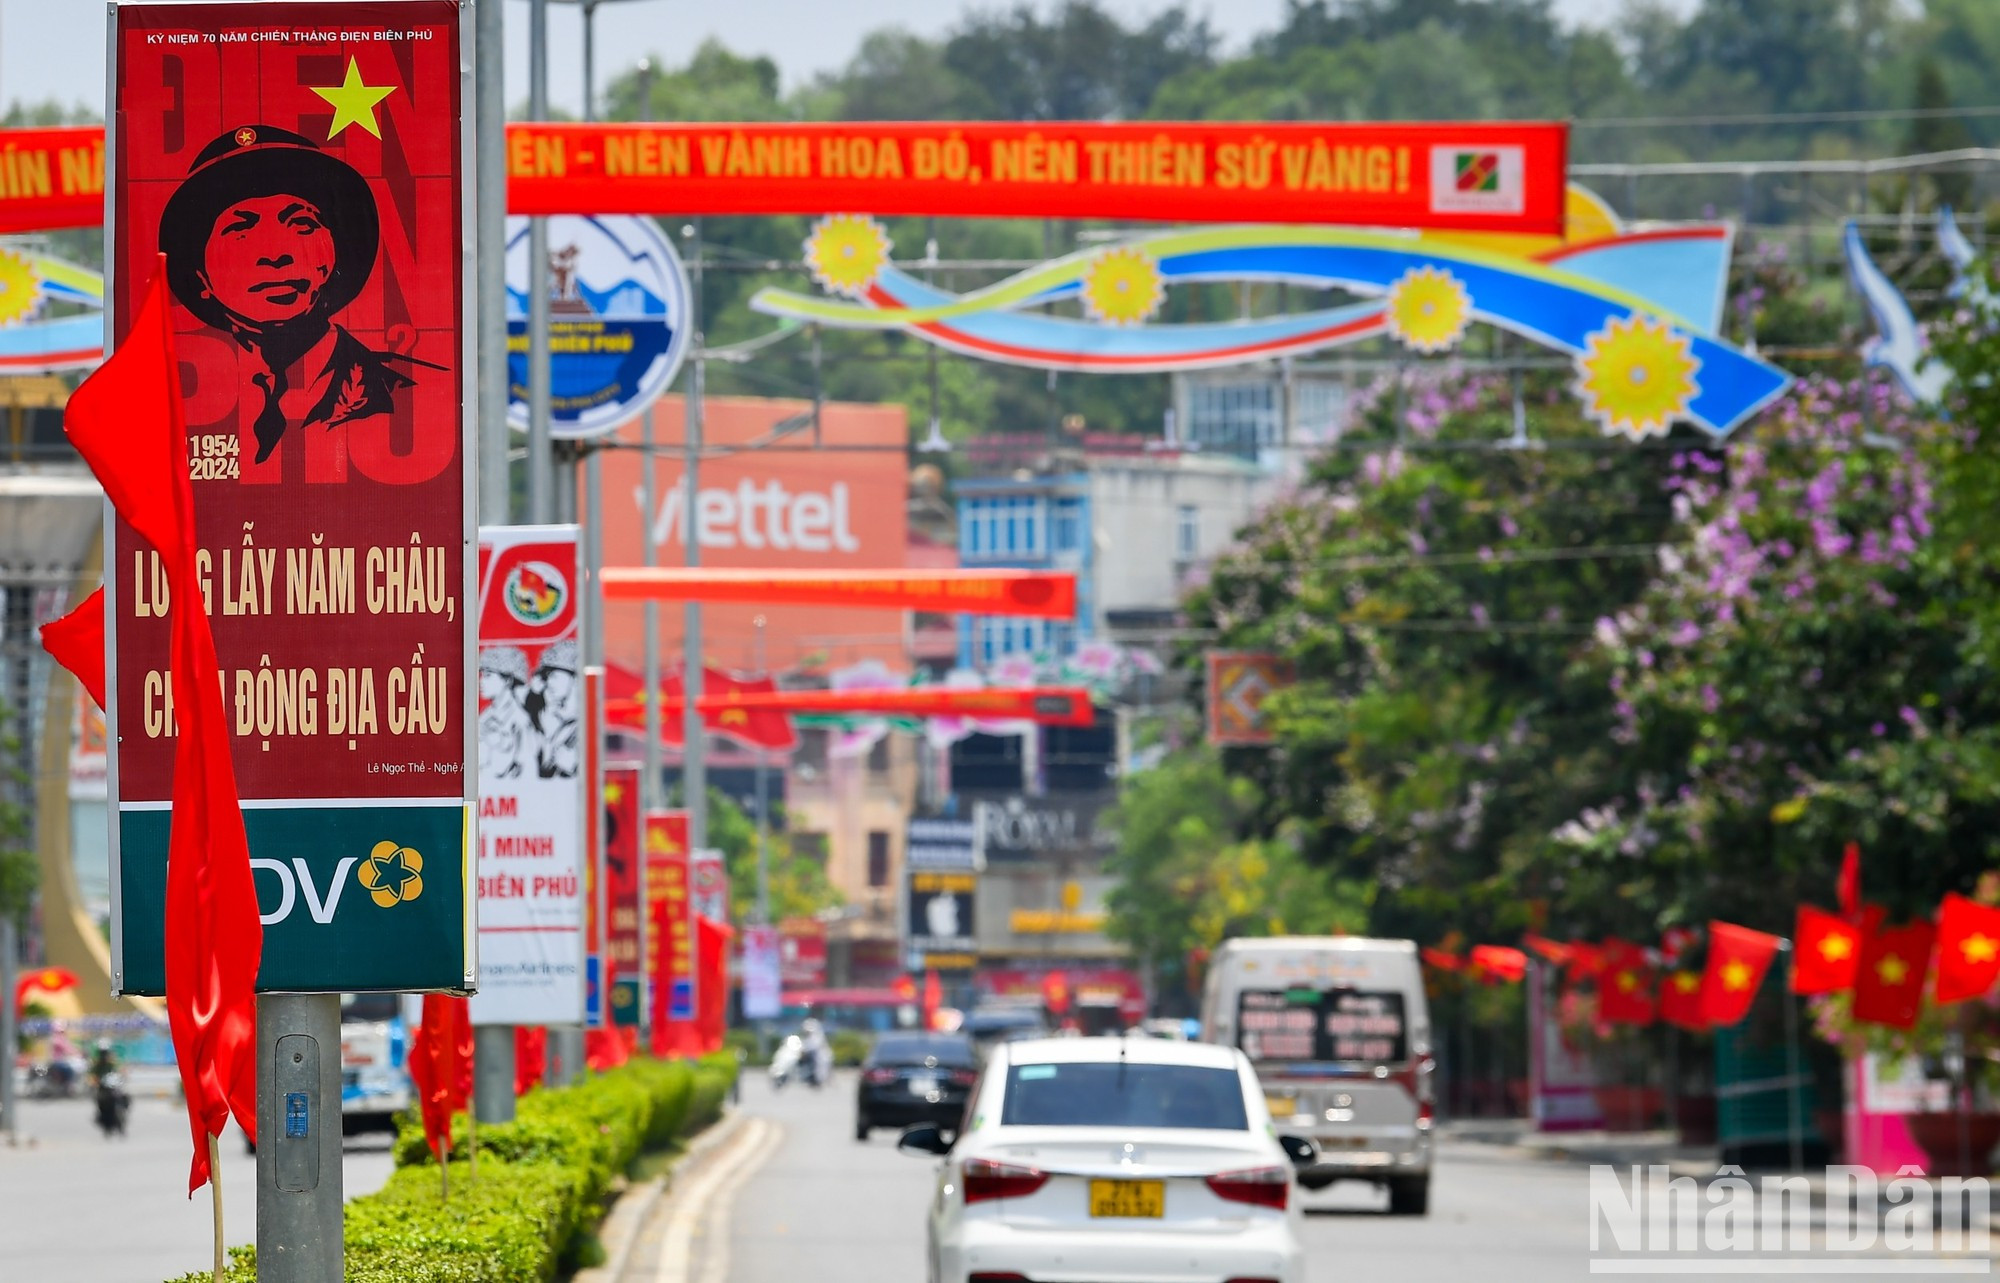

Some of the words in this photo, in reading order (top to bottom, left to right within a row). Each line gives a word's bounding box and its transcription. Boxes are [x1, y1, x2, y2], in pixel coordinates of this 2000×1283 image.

[168, 34, 199, 46] NIỆM
[202, 33, 217, 43] 70
[219, 31, 248, 43] NĂM
[340, 31, 370, 44] ĐIỆN
[373, 28, 403, 41] BIÊN
[407, 28, 433, 40] PHỦ
[604, 129, 691, 177] NÊN
[699, 128, 811, 178] VÀNH
[819, 136, 905, 179] HOA
[1084, 133, 1206, 188] THIÊN
[189, 434, 240, 457] 1954
[189, 457, 240, 480] 2024
[223, 521, 277, 616] LẪY
[286, 533, 355, 615] NĂM
[366, 532, 455, 622] CHÂU,
[235, 654, 318, 752] ĐỘNG
[327, 667, 378, 751] ĐỊA
[387, 643, 447, 735] CẦU
[367, 762, 380, 773] Lê
[382, 762, 406, 775] Ngọc
[434, 761, 459, 775] Nghệ
[495, 835, 554, 859] MINH
